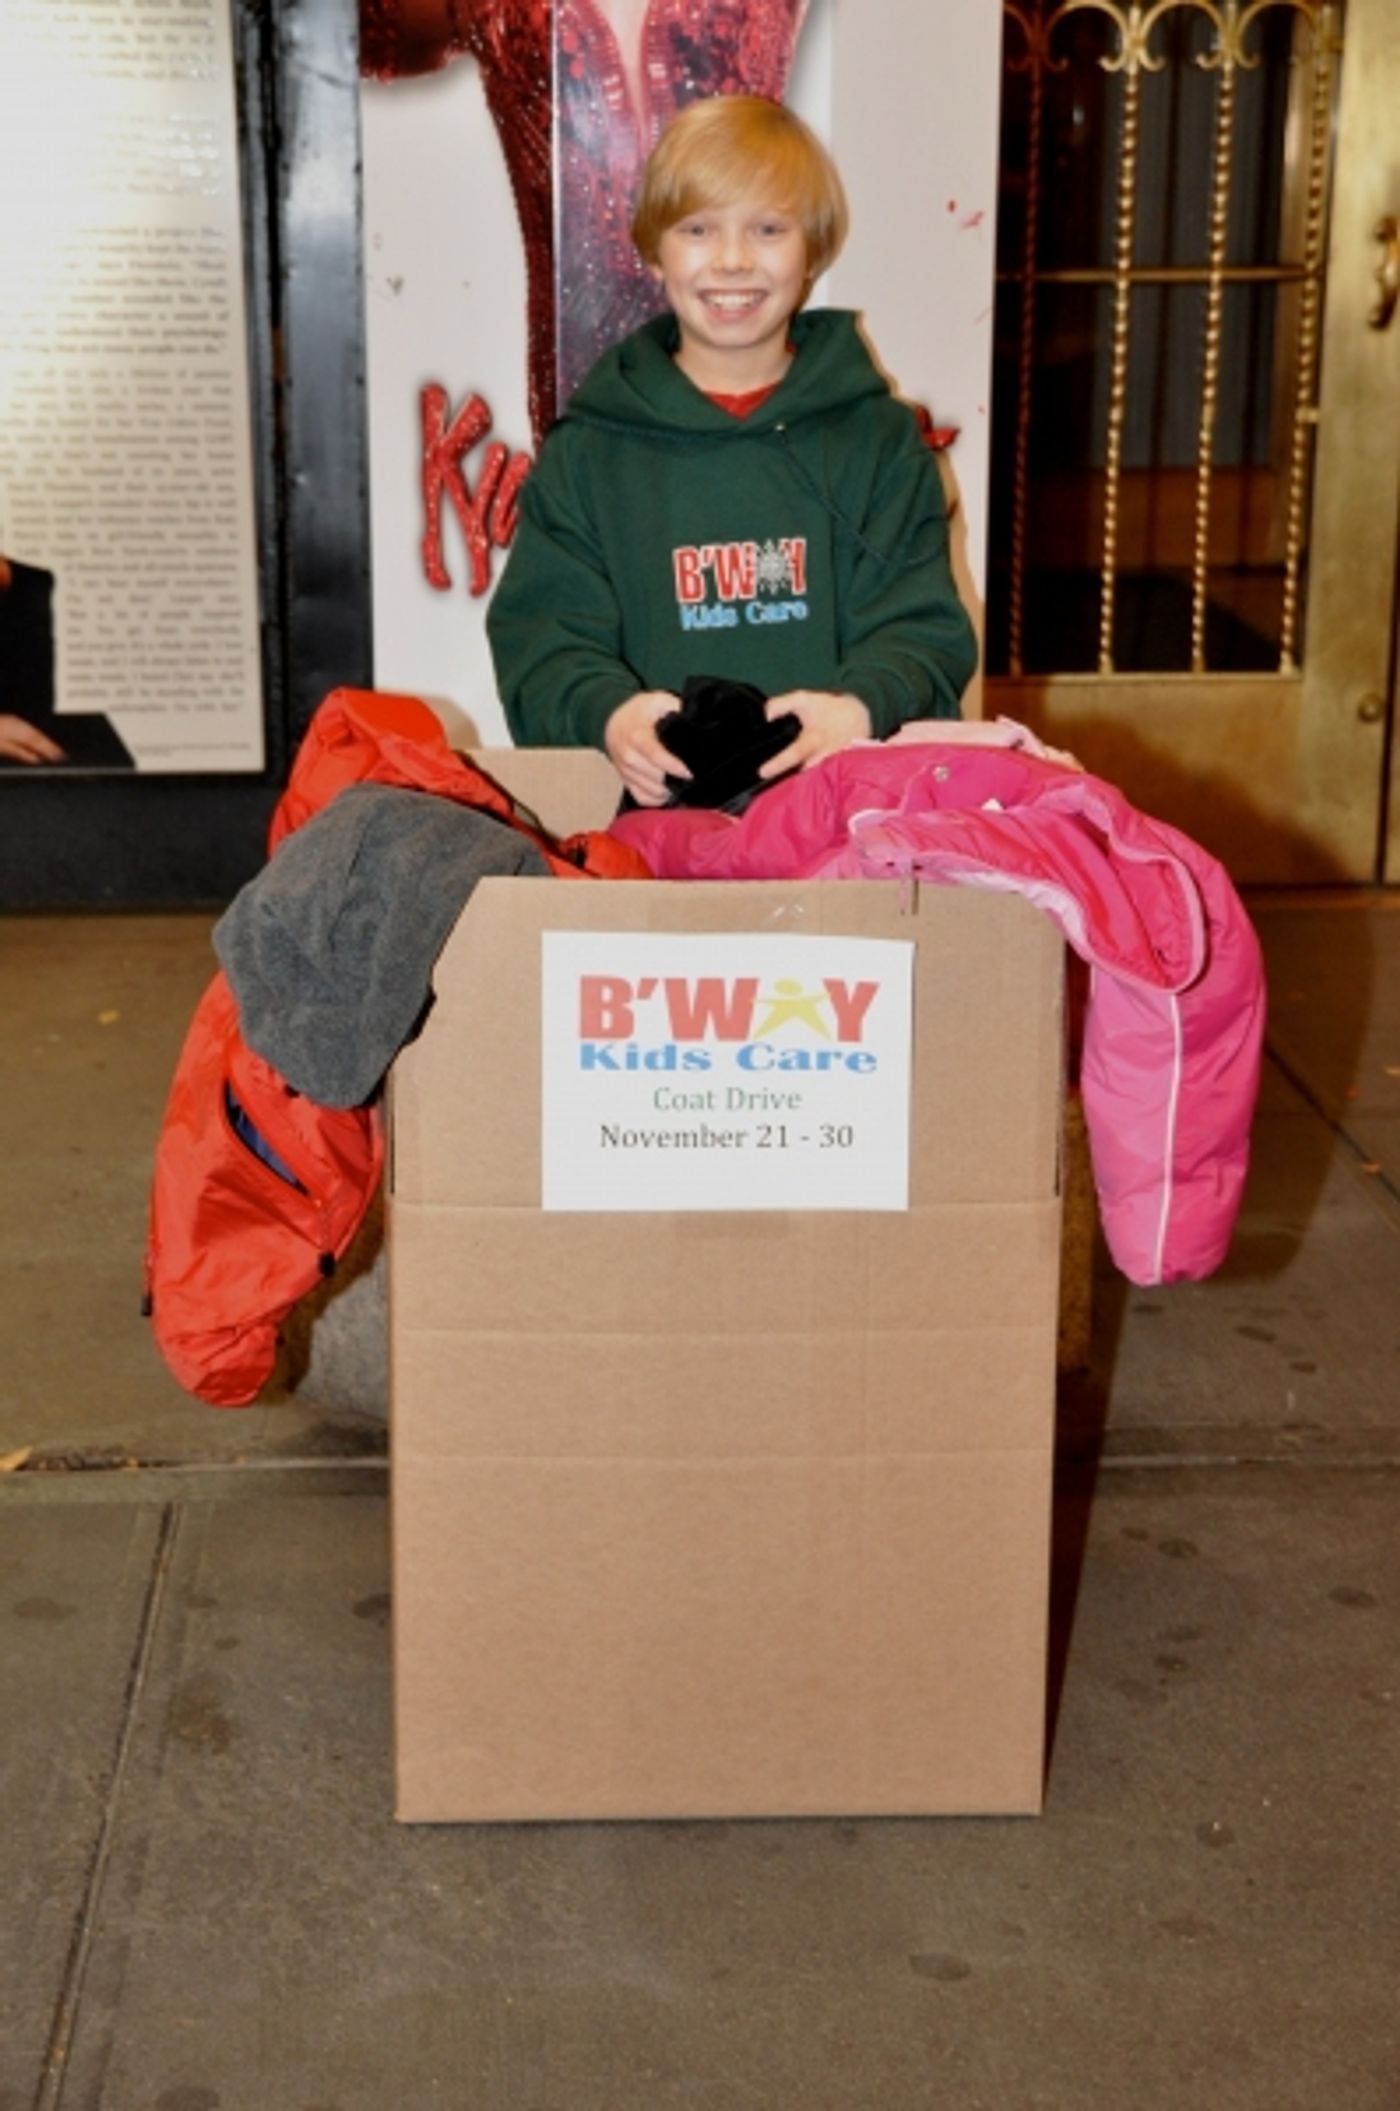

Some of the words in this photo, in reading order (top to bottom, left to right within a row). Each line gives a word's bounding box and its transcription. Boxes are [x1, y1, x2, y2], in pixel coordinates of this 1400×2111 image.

[680, 602, 739, 631] Kids
[745, 600, 808, 625] Care
[579, 1043, 712, 1072] Kids
[735, 1043, 878, 1074] Care
[653, 1086, 715, 1111] Coat
[726, 1086, 802, 1111] Drive
[600, 1123, 748, 1149] November
[756, 1123, 789, 1149] 21
[819, 1123, 854, 1149] 30
